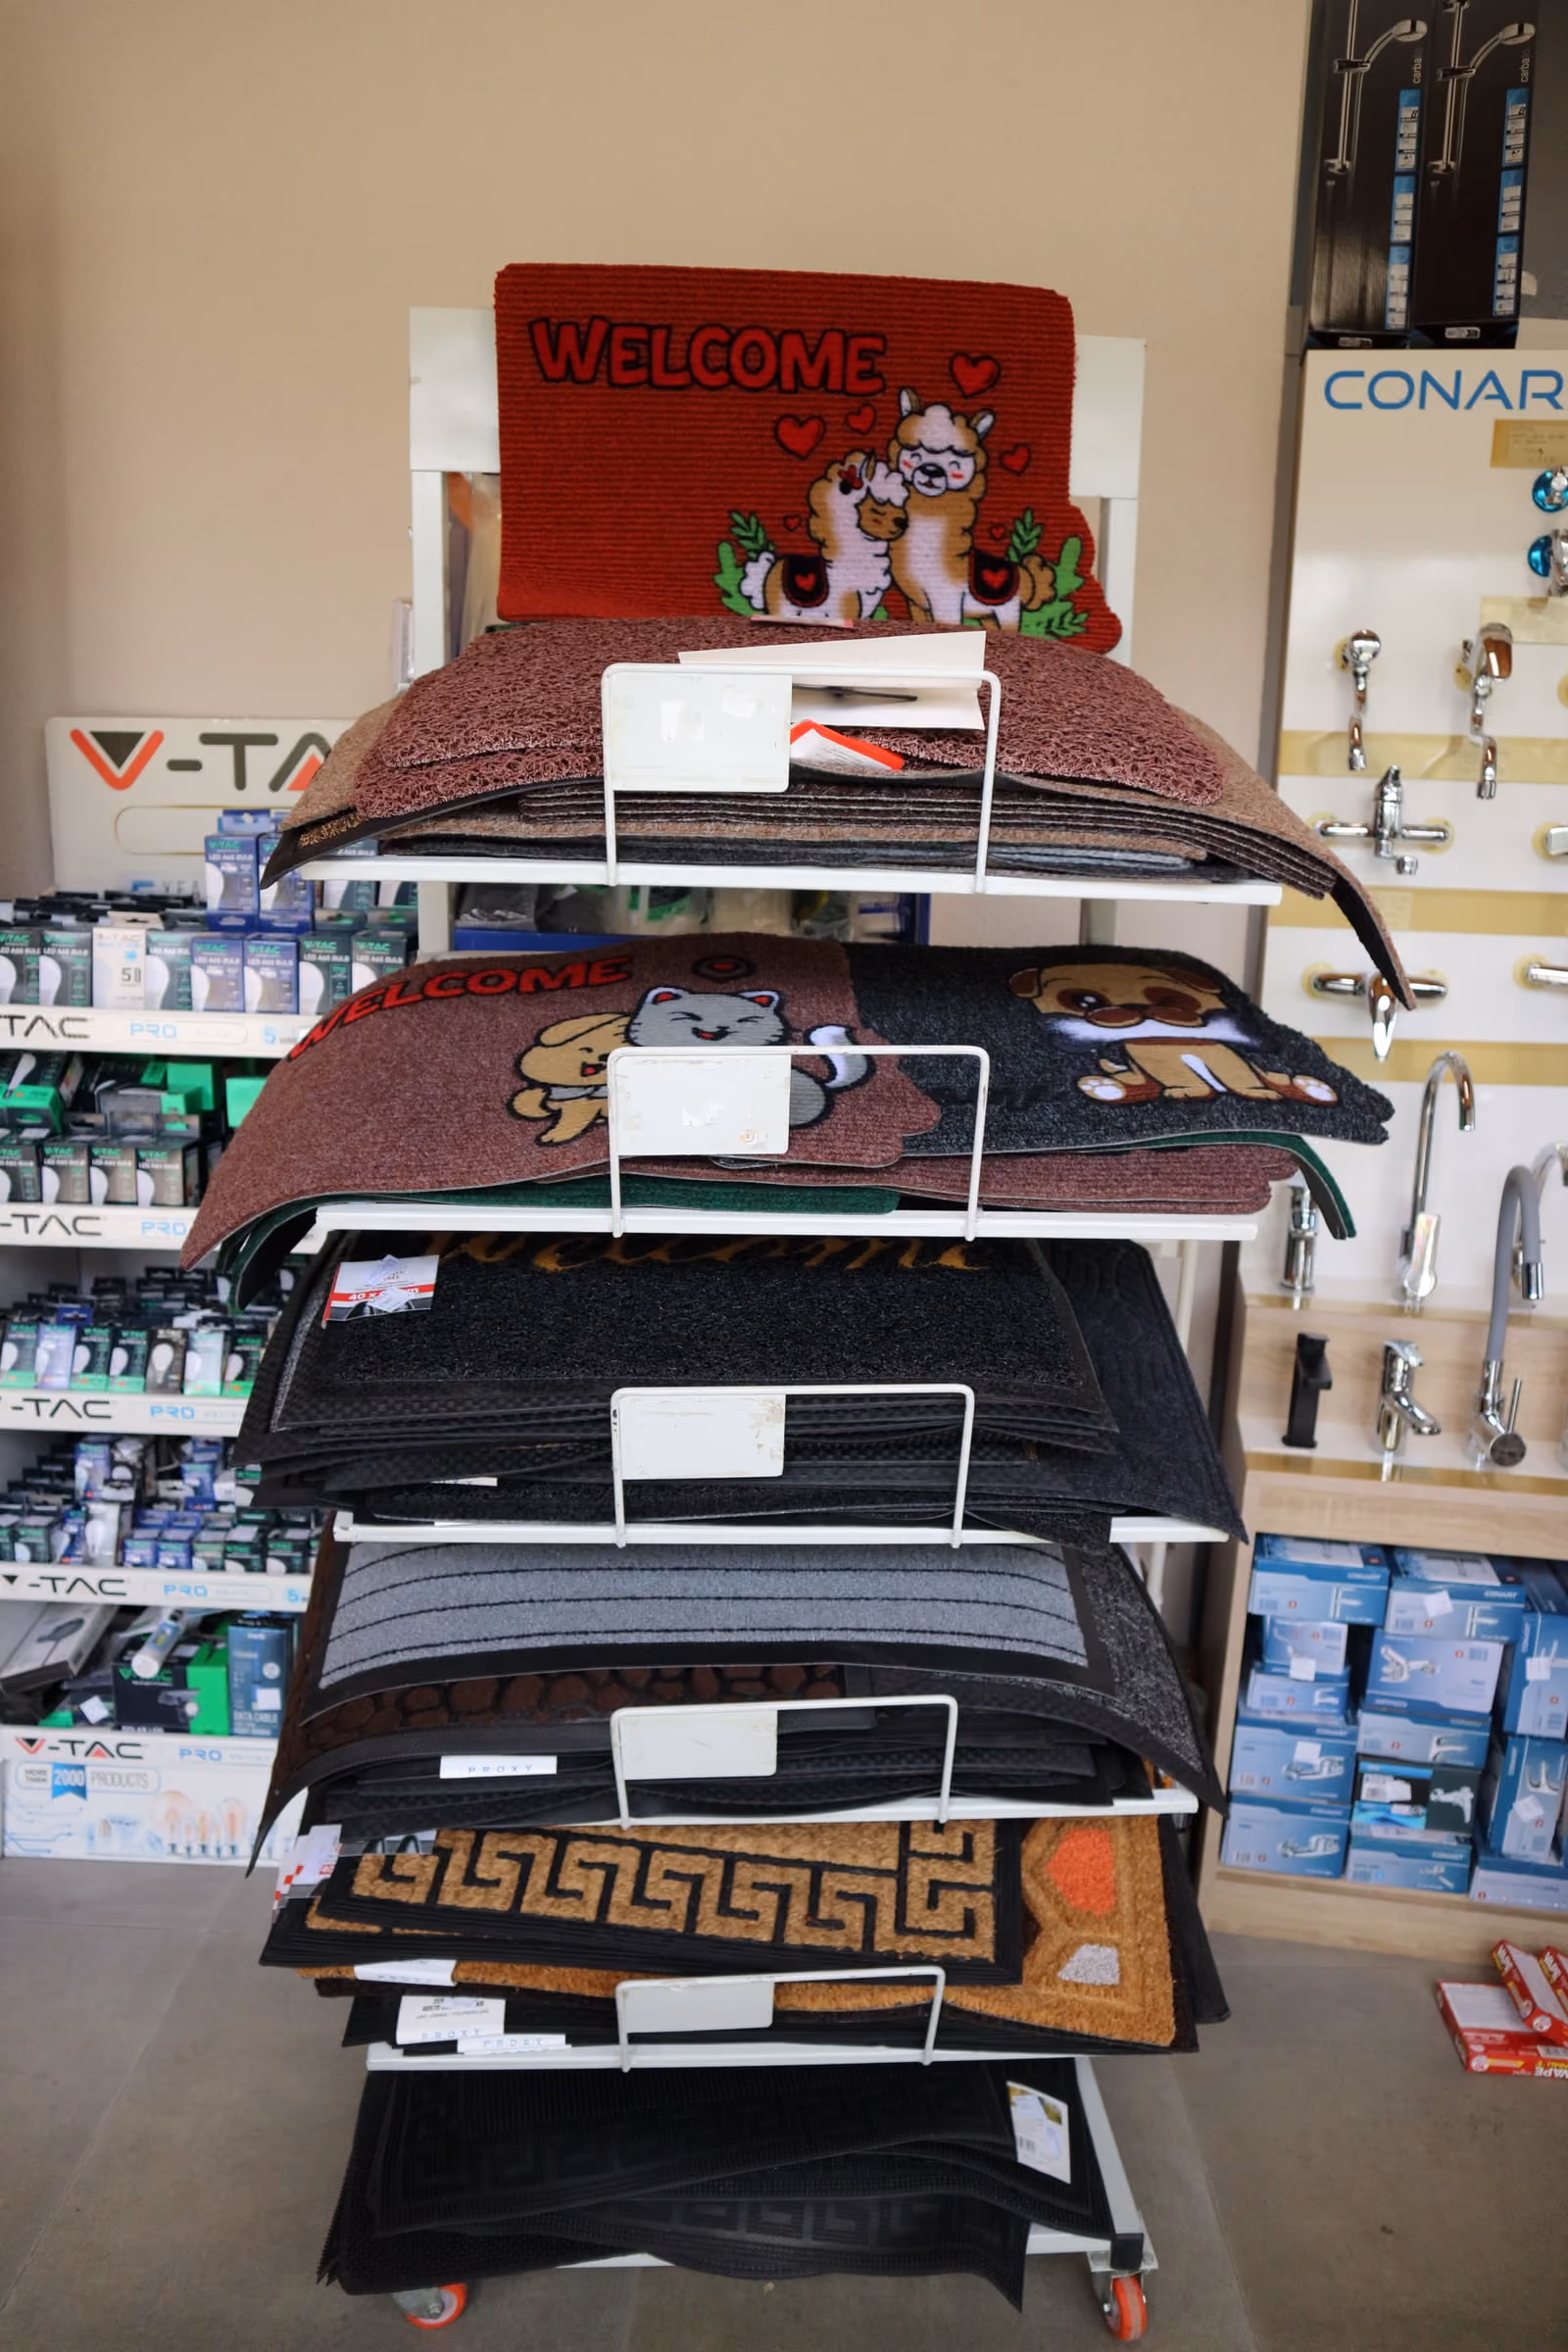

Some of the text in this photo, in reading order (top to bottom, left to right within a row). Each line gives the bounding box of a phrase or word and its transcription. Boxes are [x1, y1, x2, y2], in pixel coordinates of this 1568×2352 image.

[527, 316, 887, 395] WELCOME
[70, 728, 331, 792] V-TA
[288, 956, 633, 1061] WELCOME
[0, 1015, 176, 1039] TAC PRO
[0, 1213, 187, 1236] -TAC PRO
[10, 1398, 112, 1419] -TAC
[150, 1404, 195, 1420] PRO
[16, 1738, 143, 1759] V-TAC
[179, 1748, 222, 1761] PRO
[54, 1769, 149, 1788] 2000 PRODUCTS
